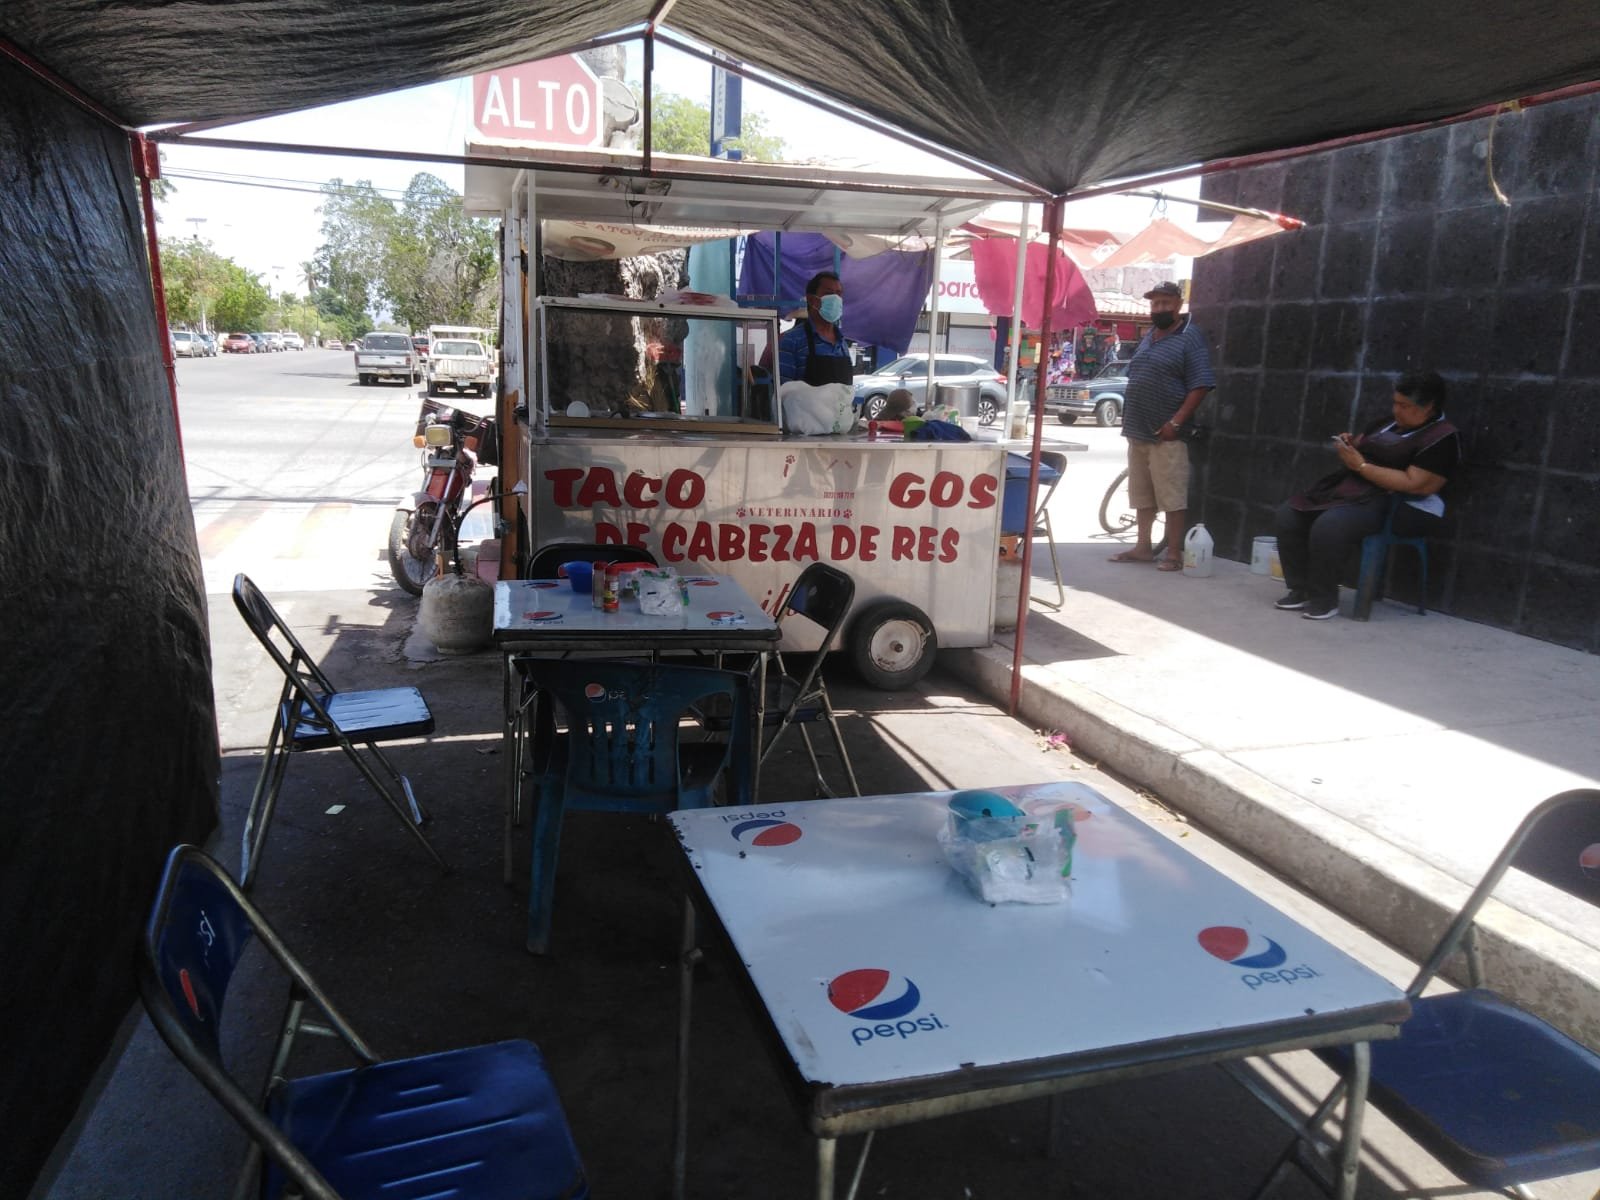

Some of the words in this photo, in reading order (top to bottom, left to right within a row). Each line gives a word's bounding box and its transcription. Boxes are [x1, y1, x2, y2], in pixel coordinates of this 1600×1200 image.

[481, 74, 590, 135] ALTO
[544, 467, 705, 509] TACO
[889, 471, 998, 509] GOS
[748, 507, 841, 518] VETERINARIO
[595, 522, 650, 549] DE
[662, 521, 819, 562] CABEZA
[831, 524, 880, 561] DE
[892, 526, 960, 563] RES
[721, 810, 786, 823] pepsi
[1241, 963, 1320, 990] pepsi
[852, 1012, 944, 1046] pepsi
